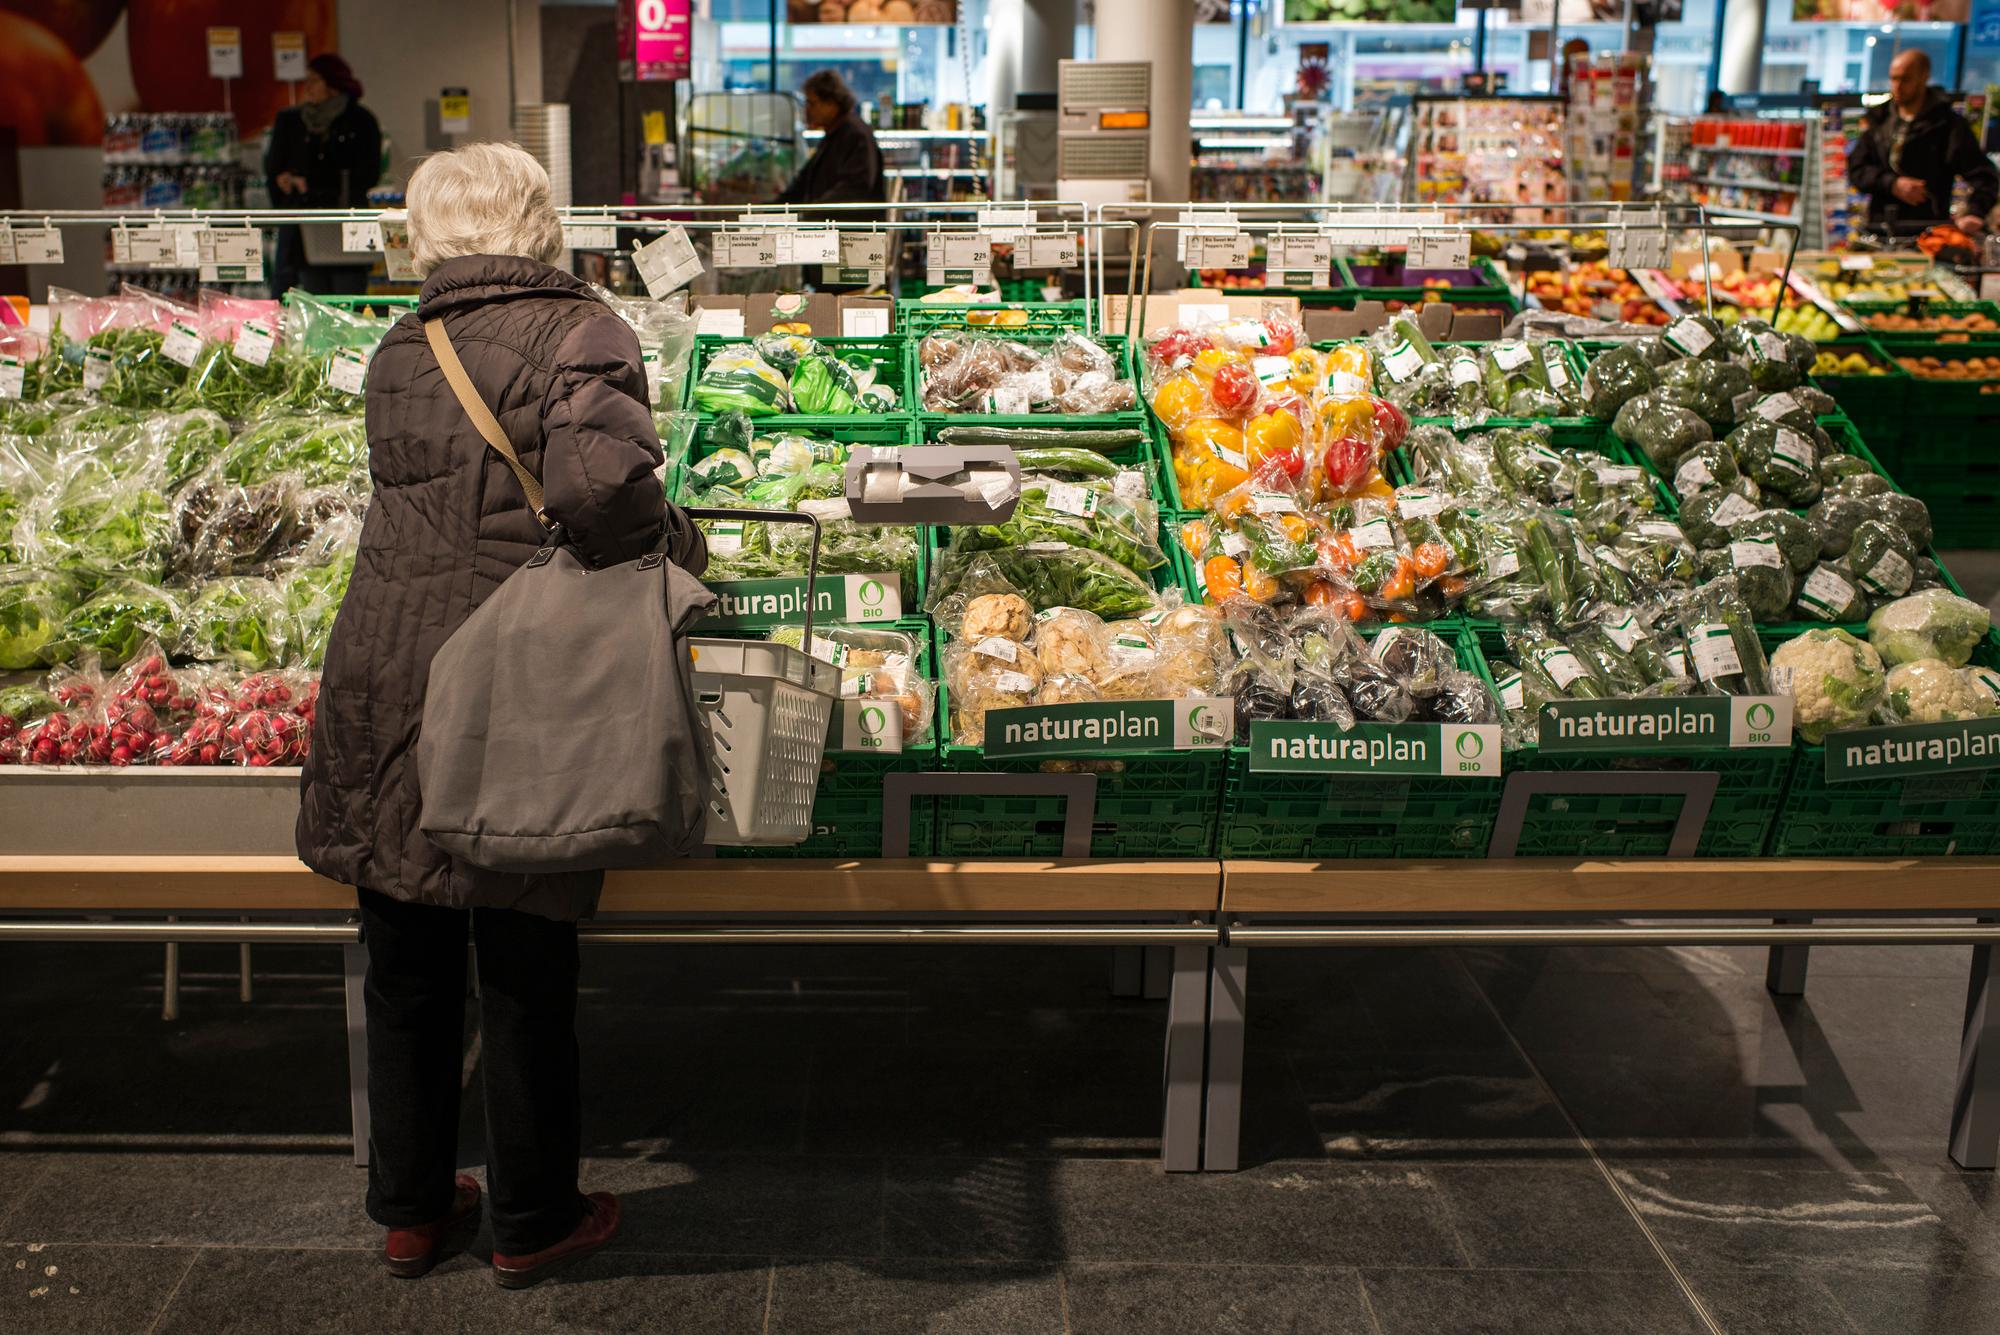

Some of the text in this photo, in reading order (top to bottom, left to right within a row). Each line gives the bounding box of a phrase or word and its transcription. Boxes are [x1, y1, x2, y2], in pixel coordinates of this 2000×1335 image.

[863, 609, 883, 617] BIO
[1005, 710, 1159, 744] naturaplan
[1559, 707, 1714, 741] naturaplan
[861, 737, 882, 746] BIO
[1748, 733, 1771, 743] BIO
[1846, 729, 2000, 767] naturaplan
[1271, 733, 1426, 767] naturaplan
[1459, 762, 1481, 771] BIO
